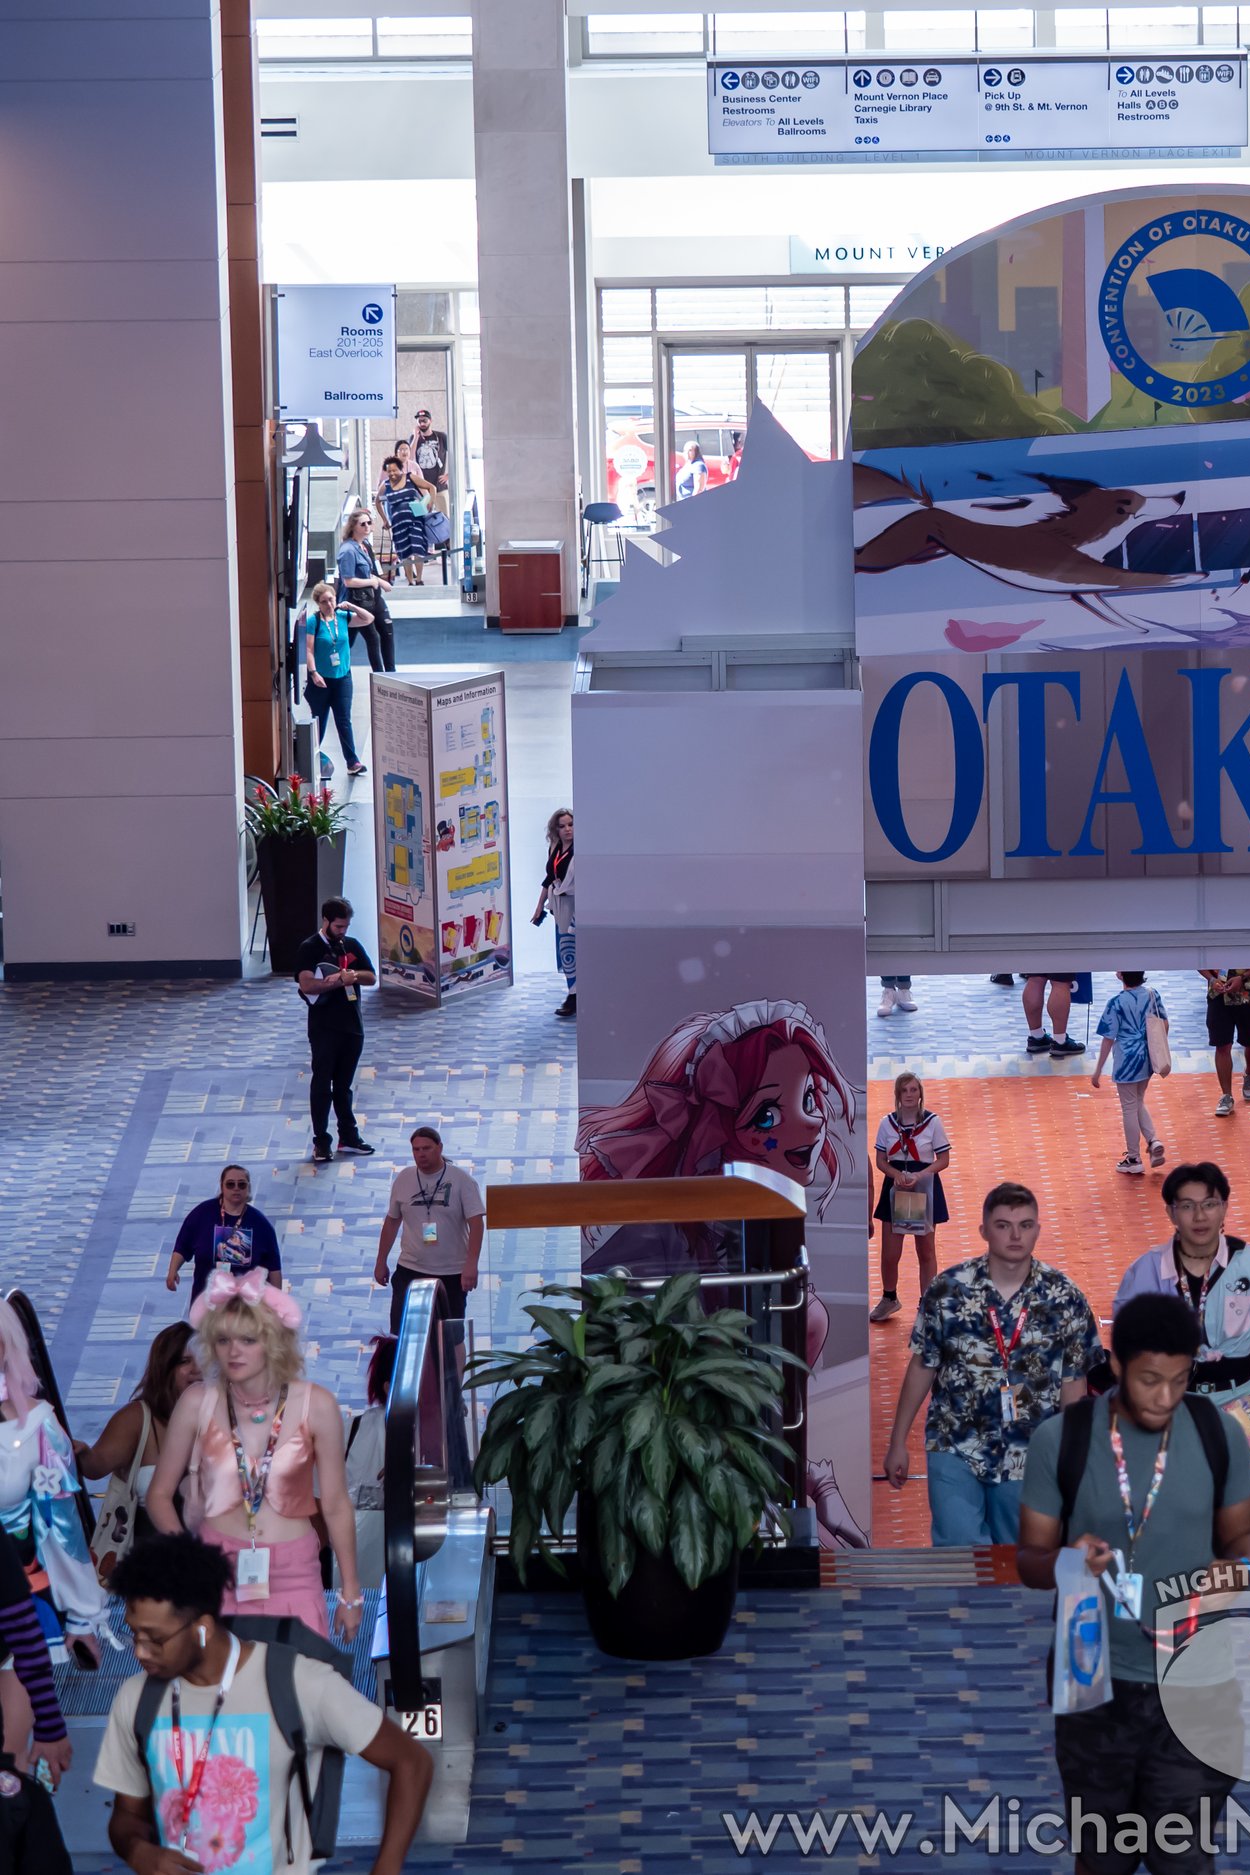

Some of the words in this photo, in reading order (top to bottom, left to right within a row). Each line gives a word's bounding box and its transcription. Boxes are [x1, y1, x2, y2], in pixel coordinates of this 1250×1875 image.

[854, 92, 885, 101] Mount
[886, 92, 921, 101] Vernon
[922, 91, 948, 100] Place
[984, 91, 1005, 100] Pick
[1007, 92, 1021, 101] Up
[1117, 89, 1128, 98] To
[1130, 89, 1143, 98] All
[1145, 89, 1176, 98] Levels
[722, 95, 767, 104] Business
[769, 94, 802, 103] Center
[722, 106, 776, 115] Restrooms
[854, 103, 897, 115] Carnegie
[899, 103, 932, 114] Library
[984, 103, 993, 112] @
[995, 103, 1011, 111] 9th
[1012, 103, 1025, 111] St.
[1028, 102, 1036, 111] &
[1037, 102, 1053, 111] Mt.
[1054, 102, 1088, 111] Vernon
[1117, 101, 1141, 110] Halls
[854, 115, 878, 124] Taxis
[1117, 112, 1170, 121] Restrooms
[722, 117, 762, 127] Elevators
[766, 118, 776, 126] To
[778, 117, 791, 126] All
[793, 117, 825, 126] Levels
[777, 127, 827, 136] Ballrooms
[722, 155, 769, 164] SOUTH
[776, 153, 844, 163] BUILDING
[865, 152, 908, 162] LEVEL
[1024, 150, 1074, 160] MOUNT
[1082, 149, 1141, 159] VERNON
[1149, 147, 1194, 158] PLACE
[1202, 147, 1233, 157] EXIT
[815, 247, 895, 261] MOUNT
[907, 246, 953, 259] VER
[1104, 241, 1145, 370] CONVENTION
[1148, 221, 1173, 241] OF
[1182, 215, 1250, 242] OTAKU
[341, 326, 384, 336] Rooms
[337, 337, 384, 348] 201-205
[309, 347, 333, 358] East
[335, 347, 383, 358] Overlook
[324, 391, 384, 401] Ballrooms
[1171, 384, 1226, 403] 2023
[436, 697, 452, 708] Maps
[453, 693, 463, 703] and
[464, 686, 497, 699] Information
[406, 1707, 438, 1736] 26
